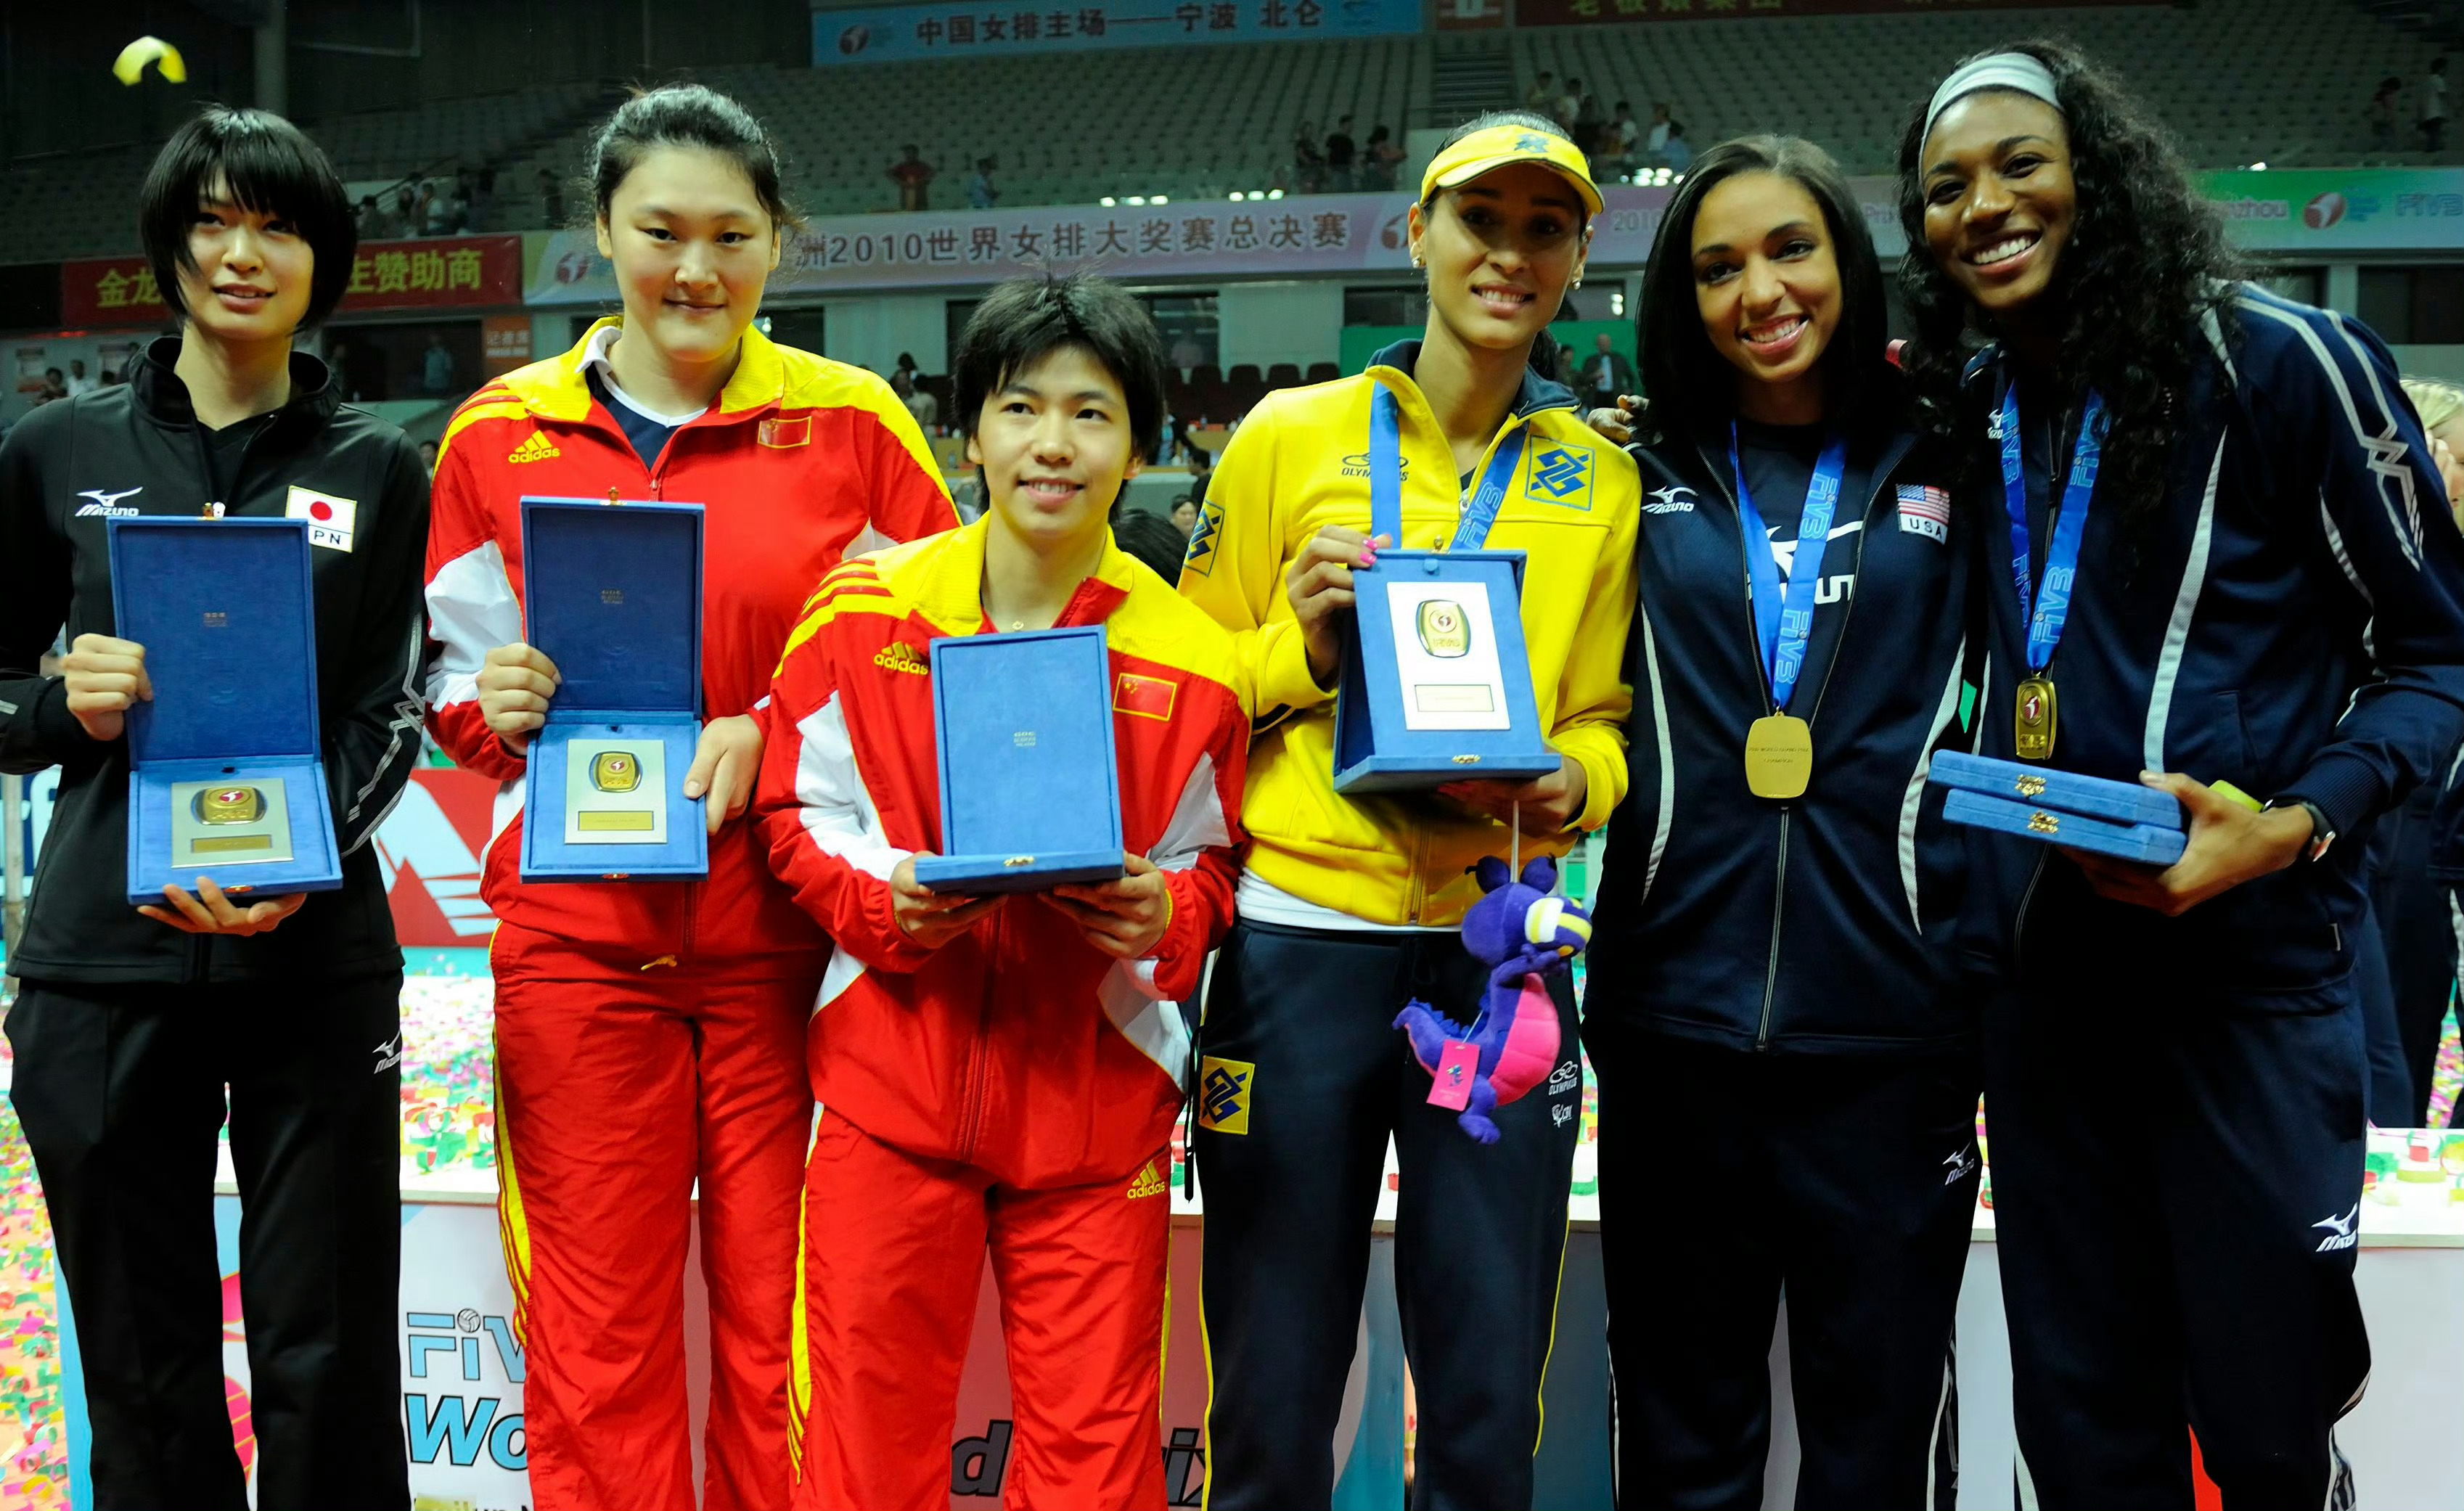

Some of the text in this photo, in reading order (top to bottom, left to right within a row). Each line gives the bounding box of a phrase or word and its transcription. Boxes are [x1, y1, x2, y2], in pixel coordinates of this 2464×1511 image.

[508, 447, 561, 463] adidas
[1341, 467, 1409, 482] OLYMS
[1910, 517, 1942, 539] USA
[313, 531, 341, 545] PN
[874, 651, 929, 676] adidas
[1127, 1180, 1165, 1200] adidas
